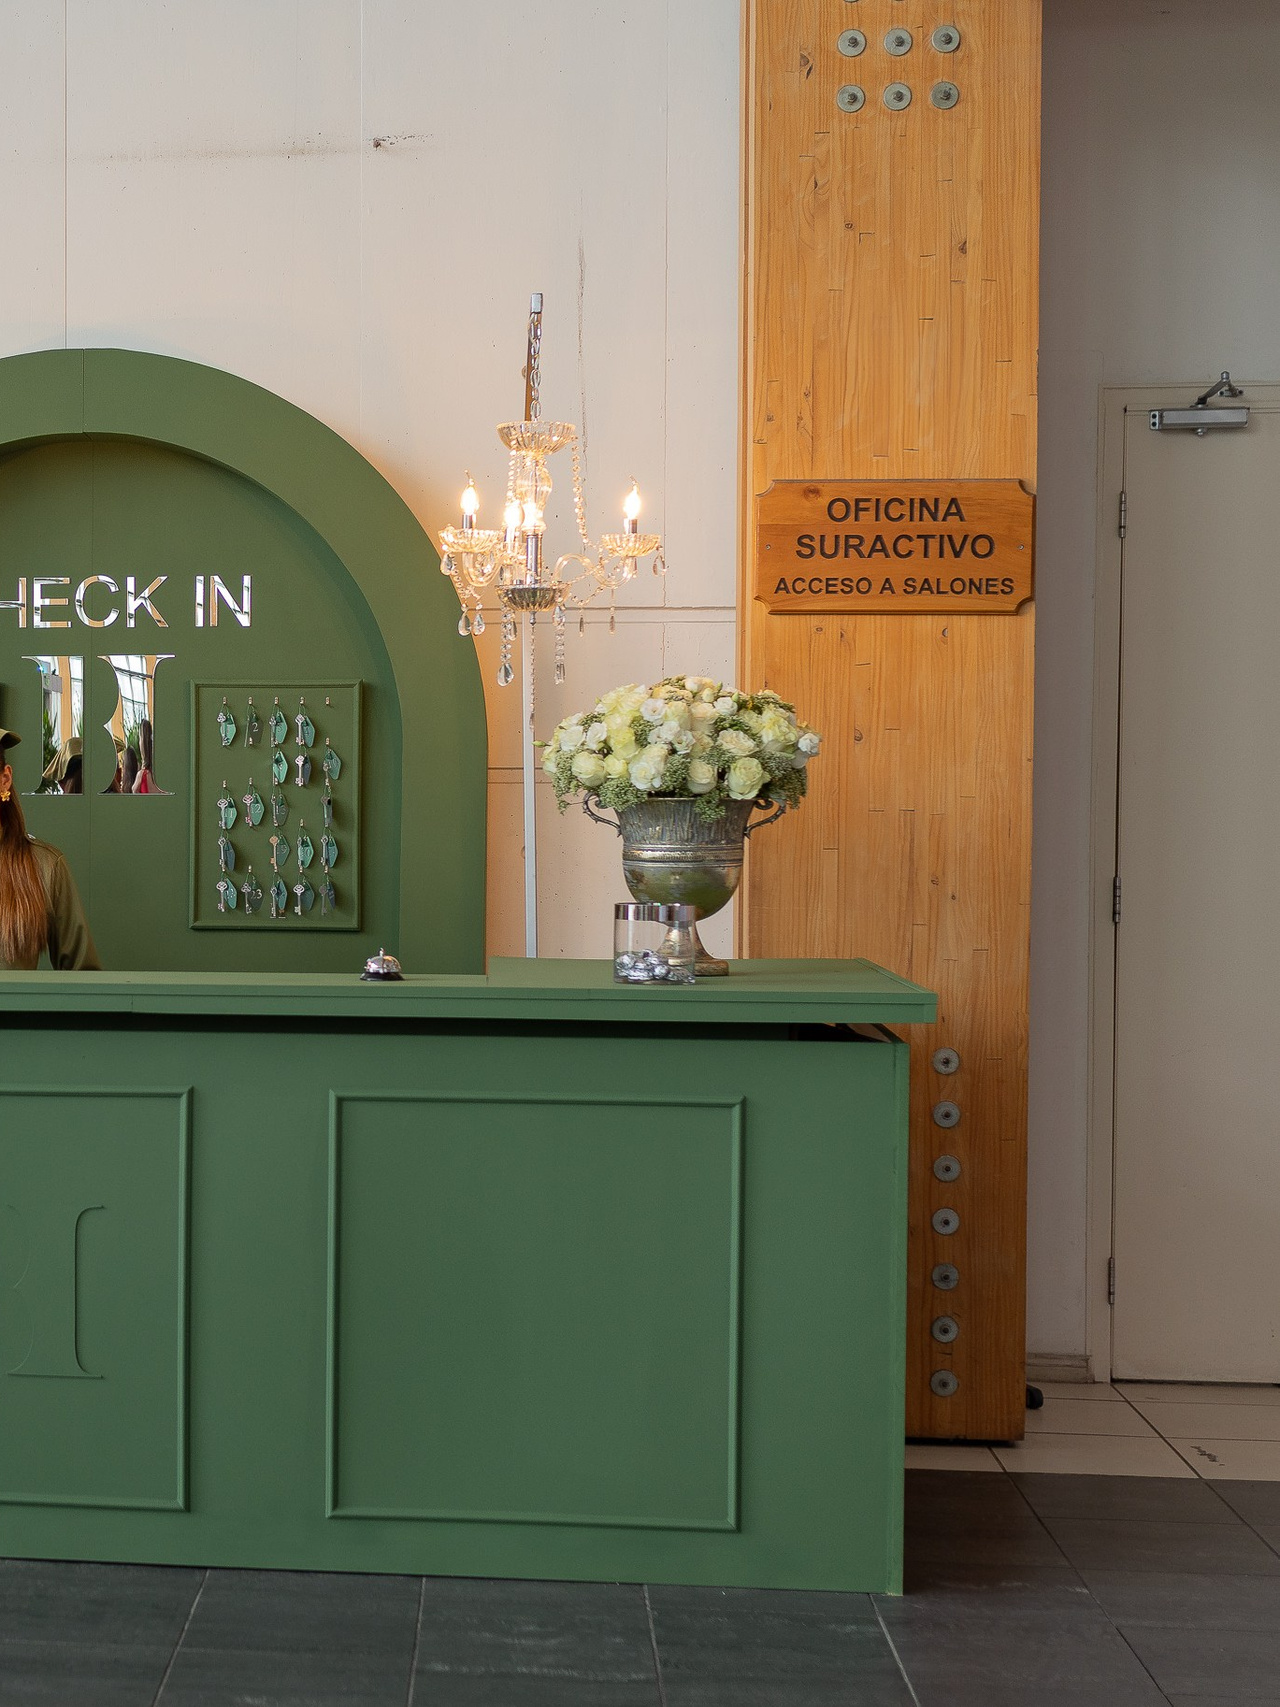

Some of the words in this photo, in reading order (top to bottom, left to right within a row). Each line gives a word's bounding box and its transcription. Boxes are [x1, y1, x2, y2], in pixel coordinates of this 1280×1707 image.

[826, 497, 966, 523] OFICINA
[795, 533, 996, 560] SURACTIVO
[773, 577, 873, 596] ACCESO
[878, 577, 896, 595] A
[902, 577, 1015, 596] SALONES
[194, 574, 253, 628] IN
[251, 722, 260, 733] 2
[250, 803, 262, 814] 12
[251, 888, 263, 900] 23
